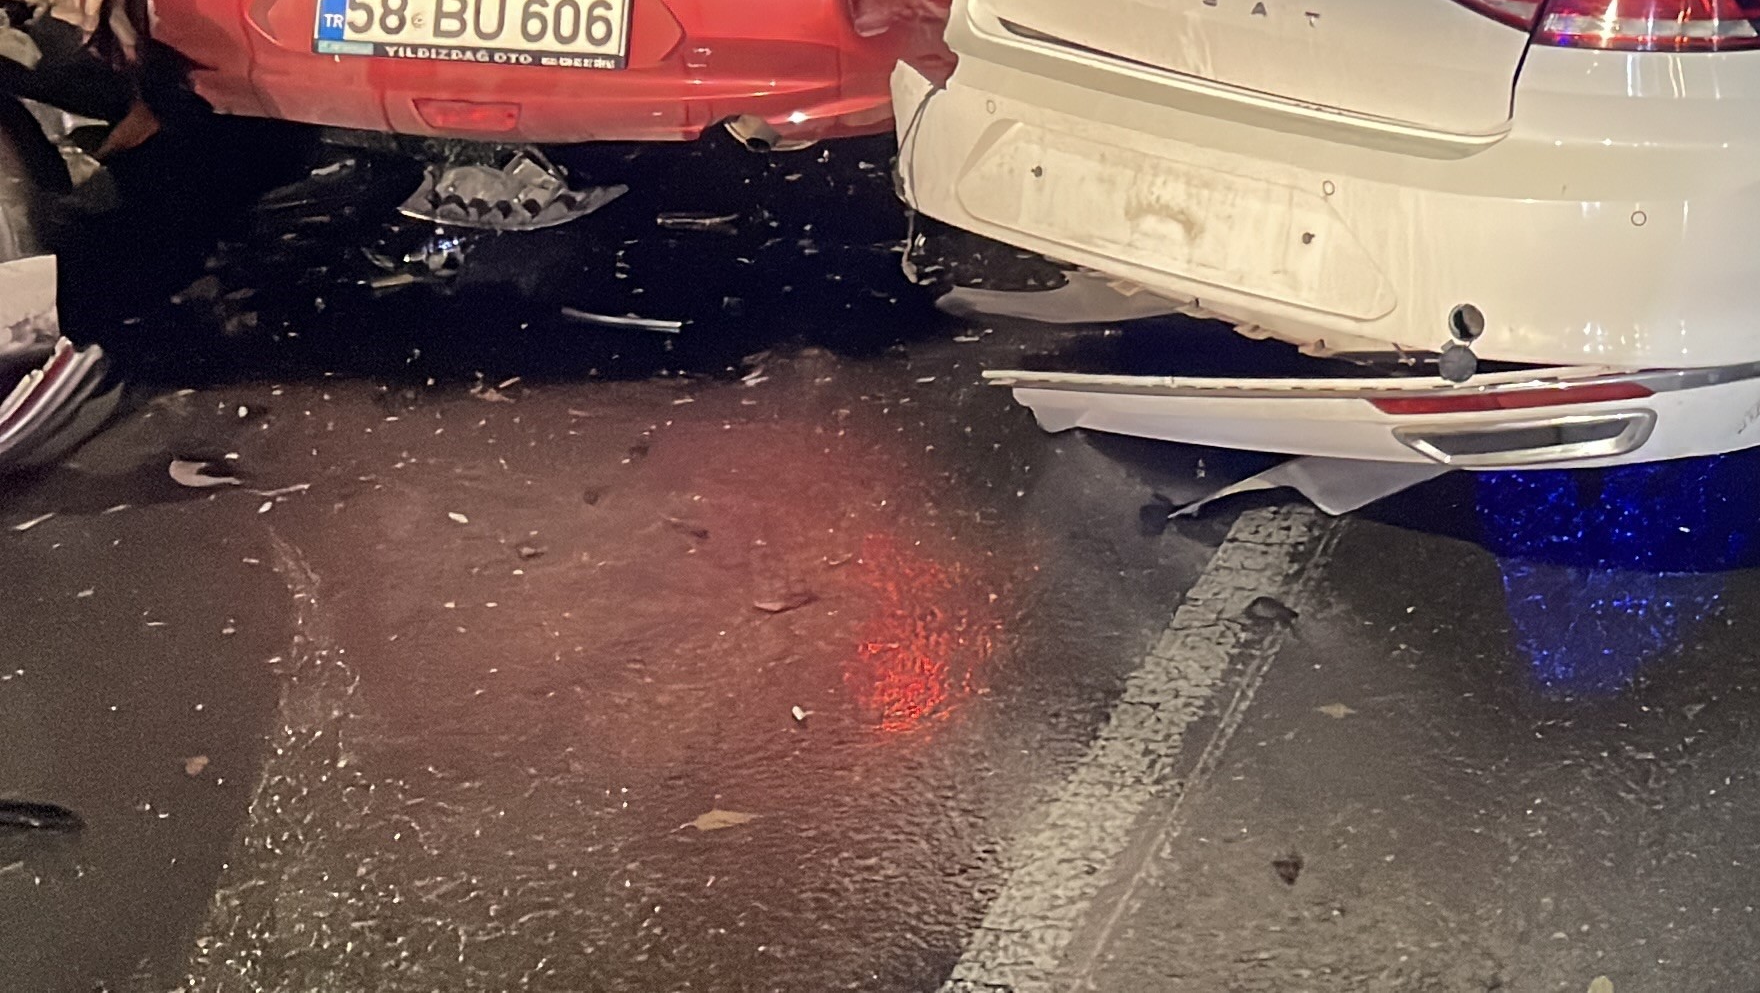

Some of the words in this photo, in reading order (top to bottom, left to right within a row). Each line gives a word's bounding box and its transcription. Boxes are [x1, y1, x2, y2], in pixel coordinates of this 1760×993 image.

[324, 13, 343, 28] TR
[383, 45, 490, 63] YILDIZDAĞ
[494, 51, 533, 65] OTO
